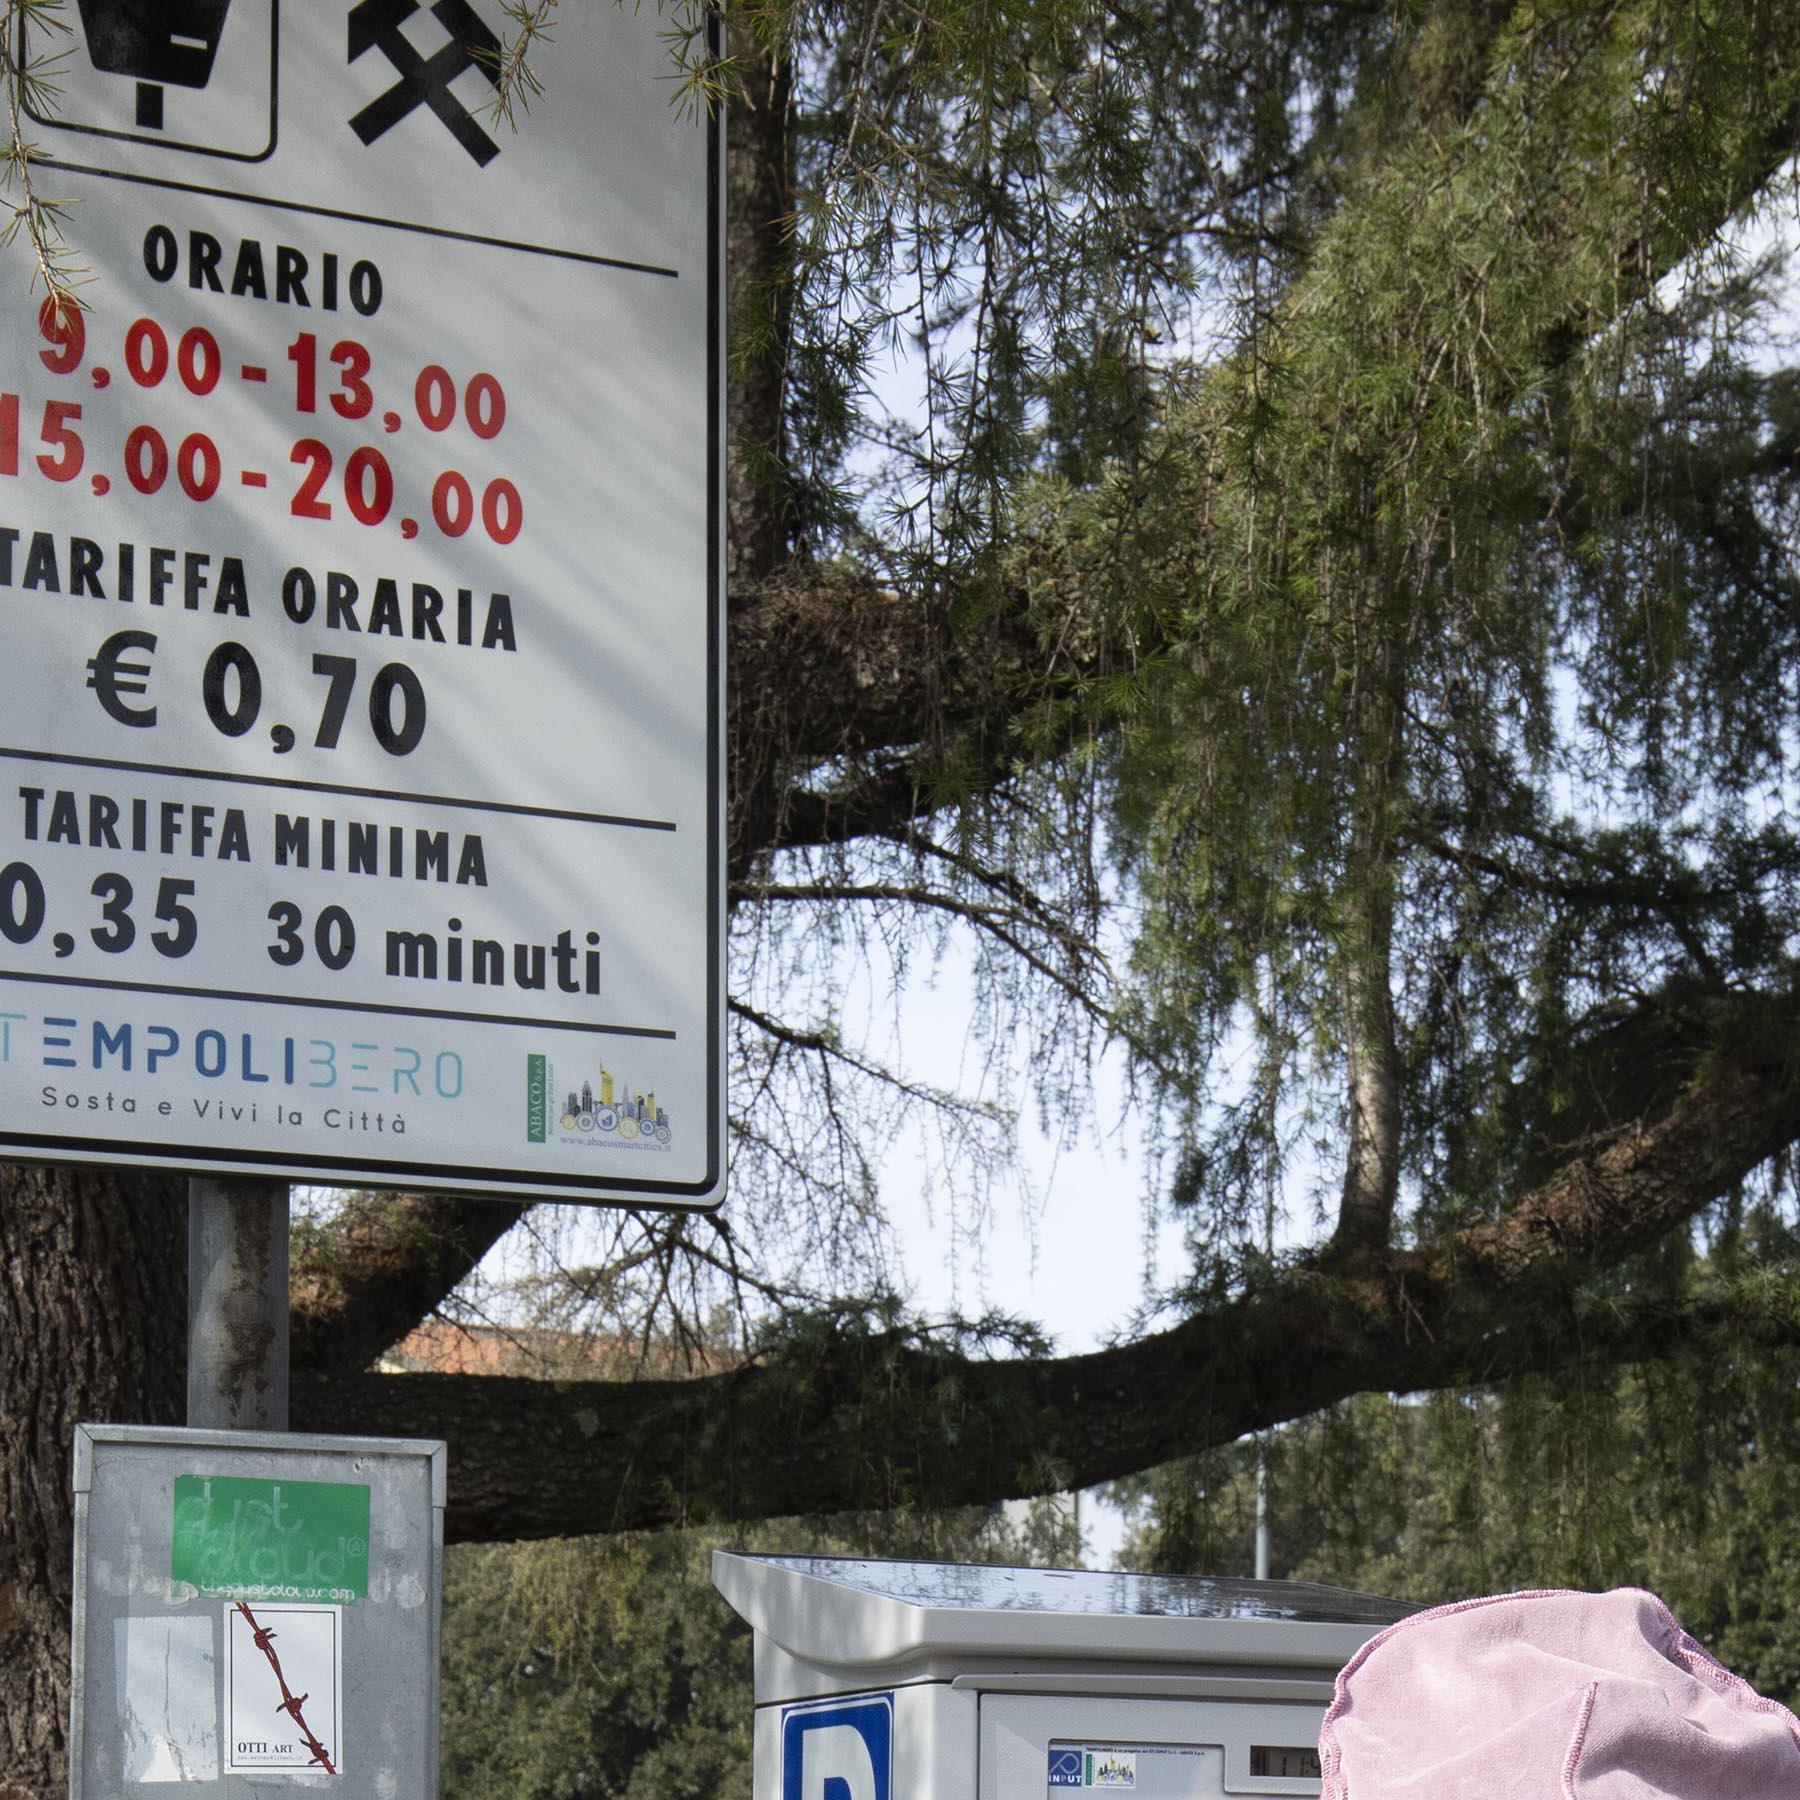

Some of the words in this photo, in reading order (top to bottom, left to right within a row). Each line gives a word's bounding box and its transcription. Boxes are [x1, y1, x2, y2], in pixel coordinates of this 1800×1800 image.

[143, 224, 382, 316] ORARIO
[282, 567, 516, 651] ORARIA
[86, 630, 157, 728] €
[203, 642, 426, 756] 0,70
[19, 787, 250, 862] TARIFFA
[275, 814, 487, 886] MINIMA
[268, 901, 355, 970] 30
[386, 918, 599, 994] minuti
[42, 1086, 136, 1113] Sosta
[158, 1099, 172, 1116] e
[193, 1098, 258, 1123] Vivi
[278, 1106, 302, 1126] la
[324, 1109, 406, 1134] Città
[530, 1082, 541, 1137] ABACO
[238, 1742, 267, 1754] OTTI
[272, 1744, 294, 1754] ART
[1049, 1774, 1082, 1783] INPUT
